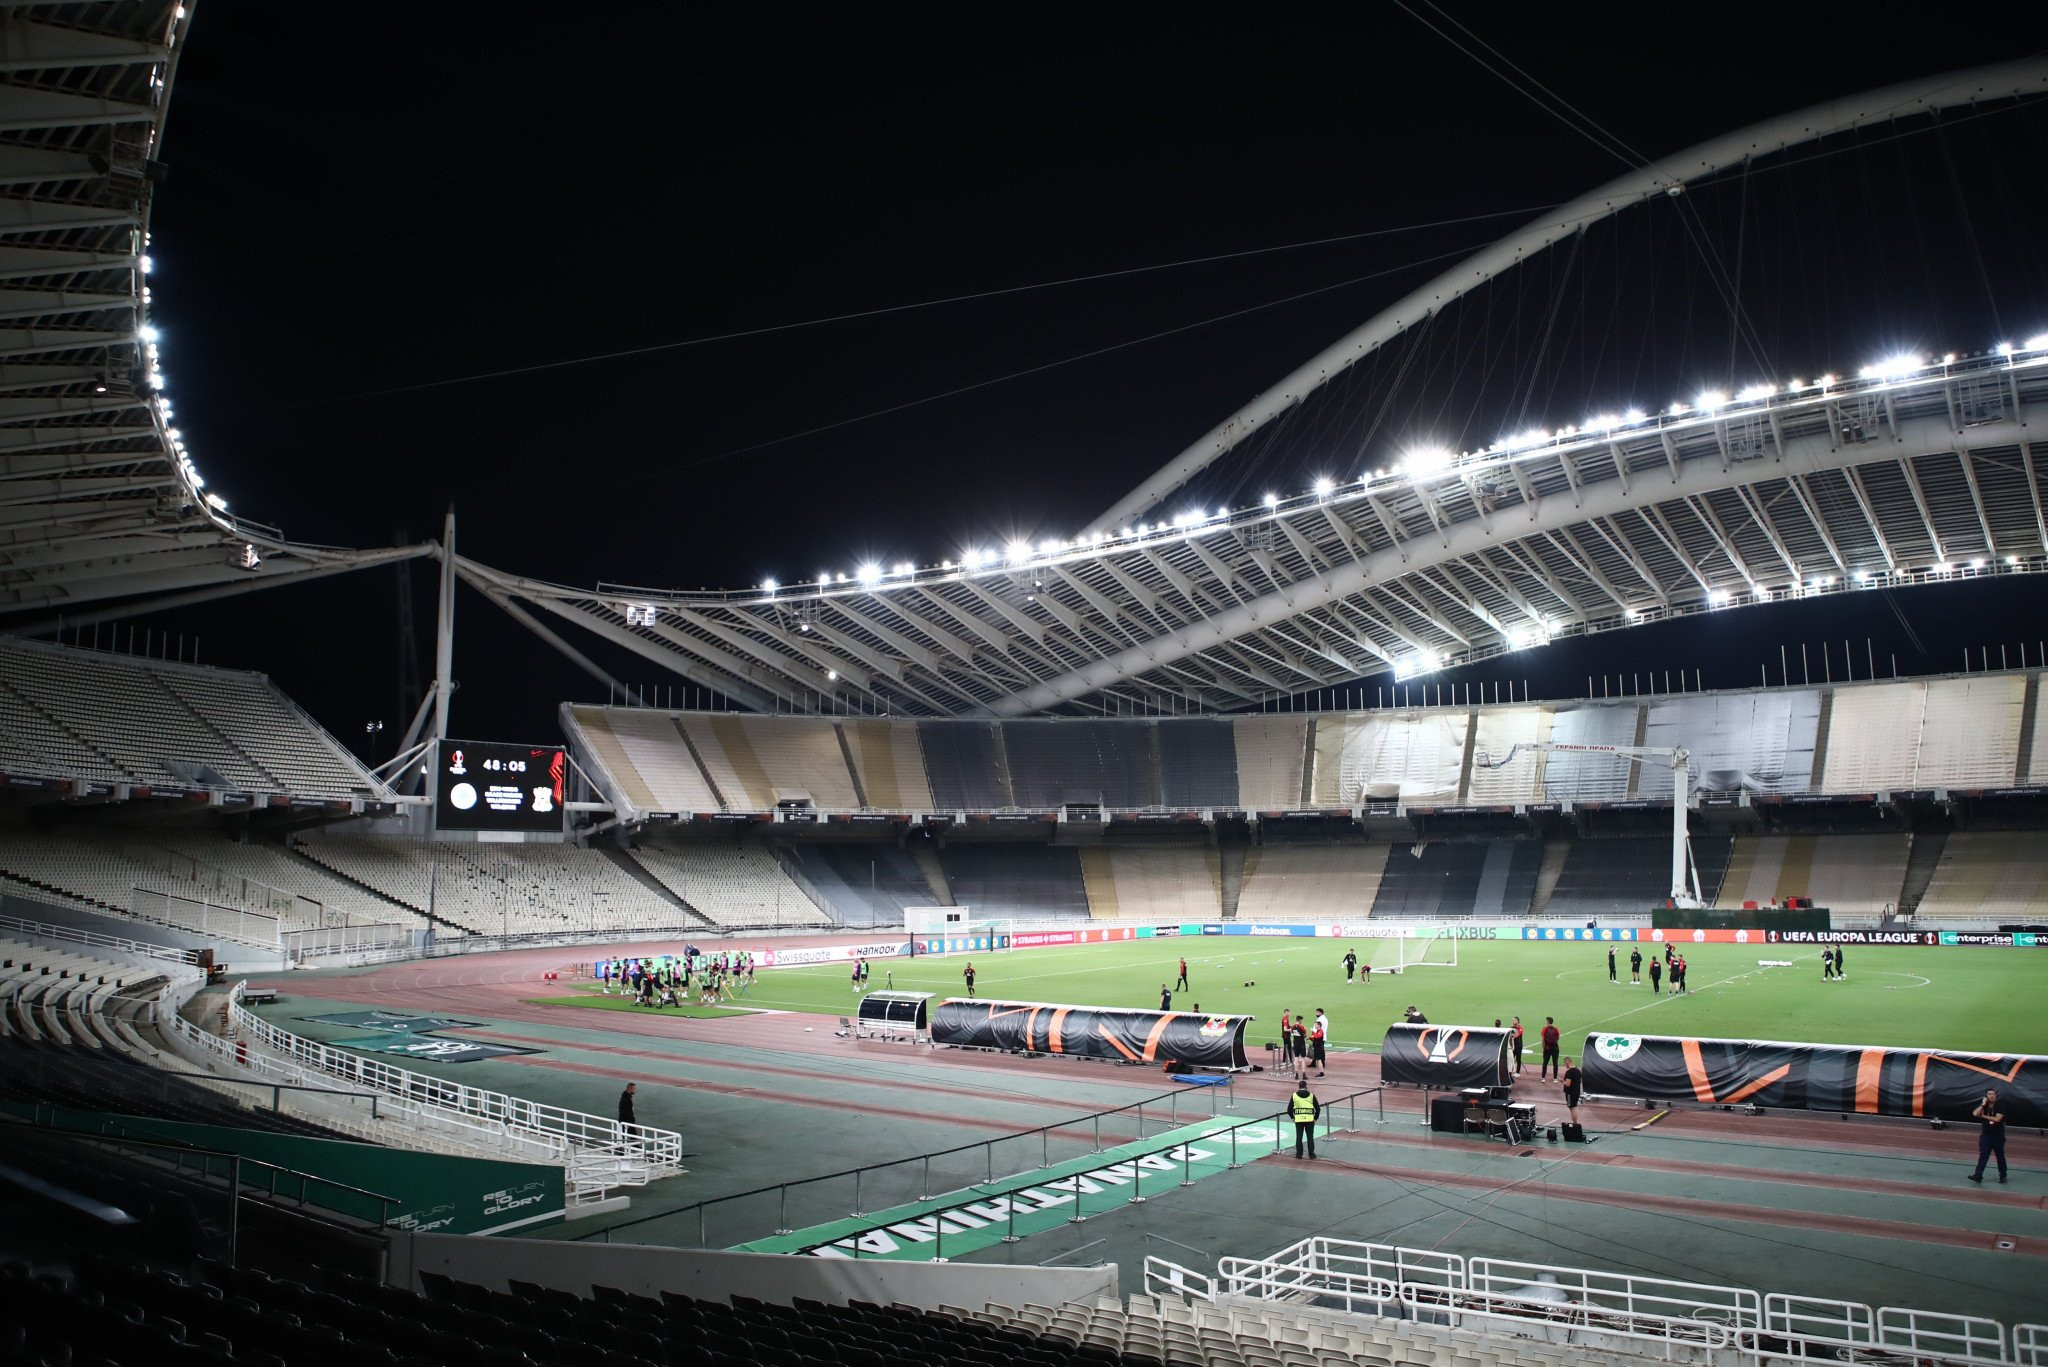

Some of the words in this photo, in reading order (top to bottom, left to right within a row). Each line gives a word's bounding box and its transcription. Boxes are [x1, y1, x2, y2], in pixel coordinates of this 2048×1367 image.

[483, 758, 527, 772] 48:05
[1343, 926, 1398, 938] Swissquote
[1782, 932, 1815, 942] UEFA
[1817, 932, 1866, 942] EUROPA
[1868, 932, 1918, 943] LEAGUE
[1018, 935, 1043, 945] STRAUSS
[1049, 934, 1073, 943] STRAUSS
[1946, 934, 2012, 944] enterprise
[776, 951, 831, 964] Swissquote
[483, 1180, 545, 1202] RETURN
[483, 1193, 545, 1216] GLORY
[496, 1195, 513, 1205] TO
[386, 1202, 455, 1226] RETURN
[400, 1219, 419, 1230] TO
[413, 1216, 455, 1233] ORY
